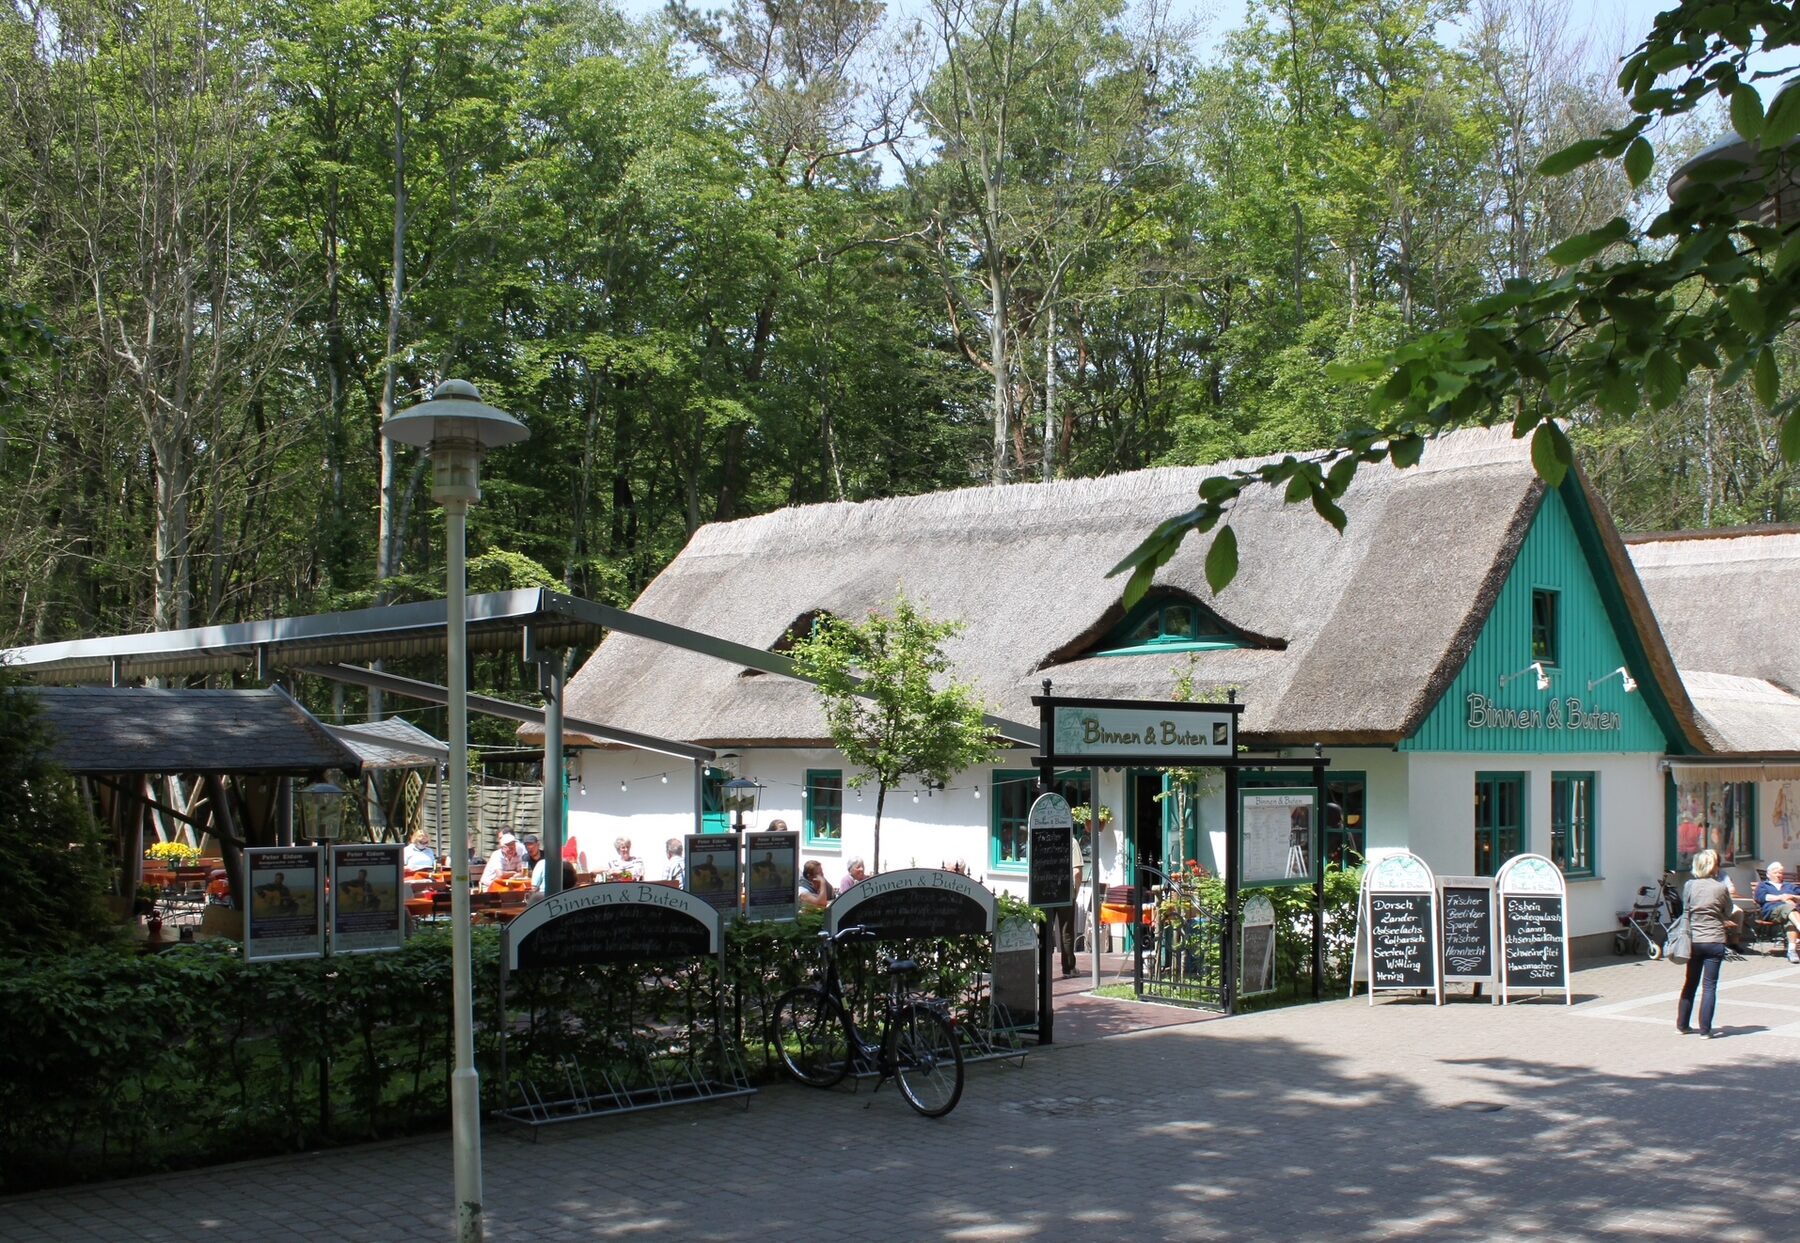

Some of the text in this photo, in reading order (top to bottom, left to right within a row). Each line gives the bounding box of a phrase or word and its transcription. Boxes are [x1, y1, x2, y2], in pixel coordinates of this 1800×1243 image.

[1467, 692, 1620, 730] Binnen & Buten
[1082, 718, 1208, 746] Binnen & Buten
[860, 879, 913, 898] Binnen
[917, 876, 926, 887] &
[932, 872, 972, 895] Buten
[545, 893, 612, 918] Binnen
[619, 889, 630, 902] &
[638, 885, 689, 910] Buten
[1372, 900, 1414, 911] Dorsch
[1446, 895, 1483, 906] Frischer
[1508, 899, 1541, 913] Eisbein
[1381, 912, 1418, 923] Zander
[1373, 925, 1423, 935] Ostseelachs
[1446, 933, 1480, 943] Frischer
[1374, 946, 1418, 959] Seeteufel
[1506, 946, 1559, 961] Schweinefilet
[1386, 959, 1421, 973] Wittling
